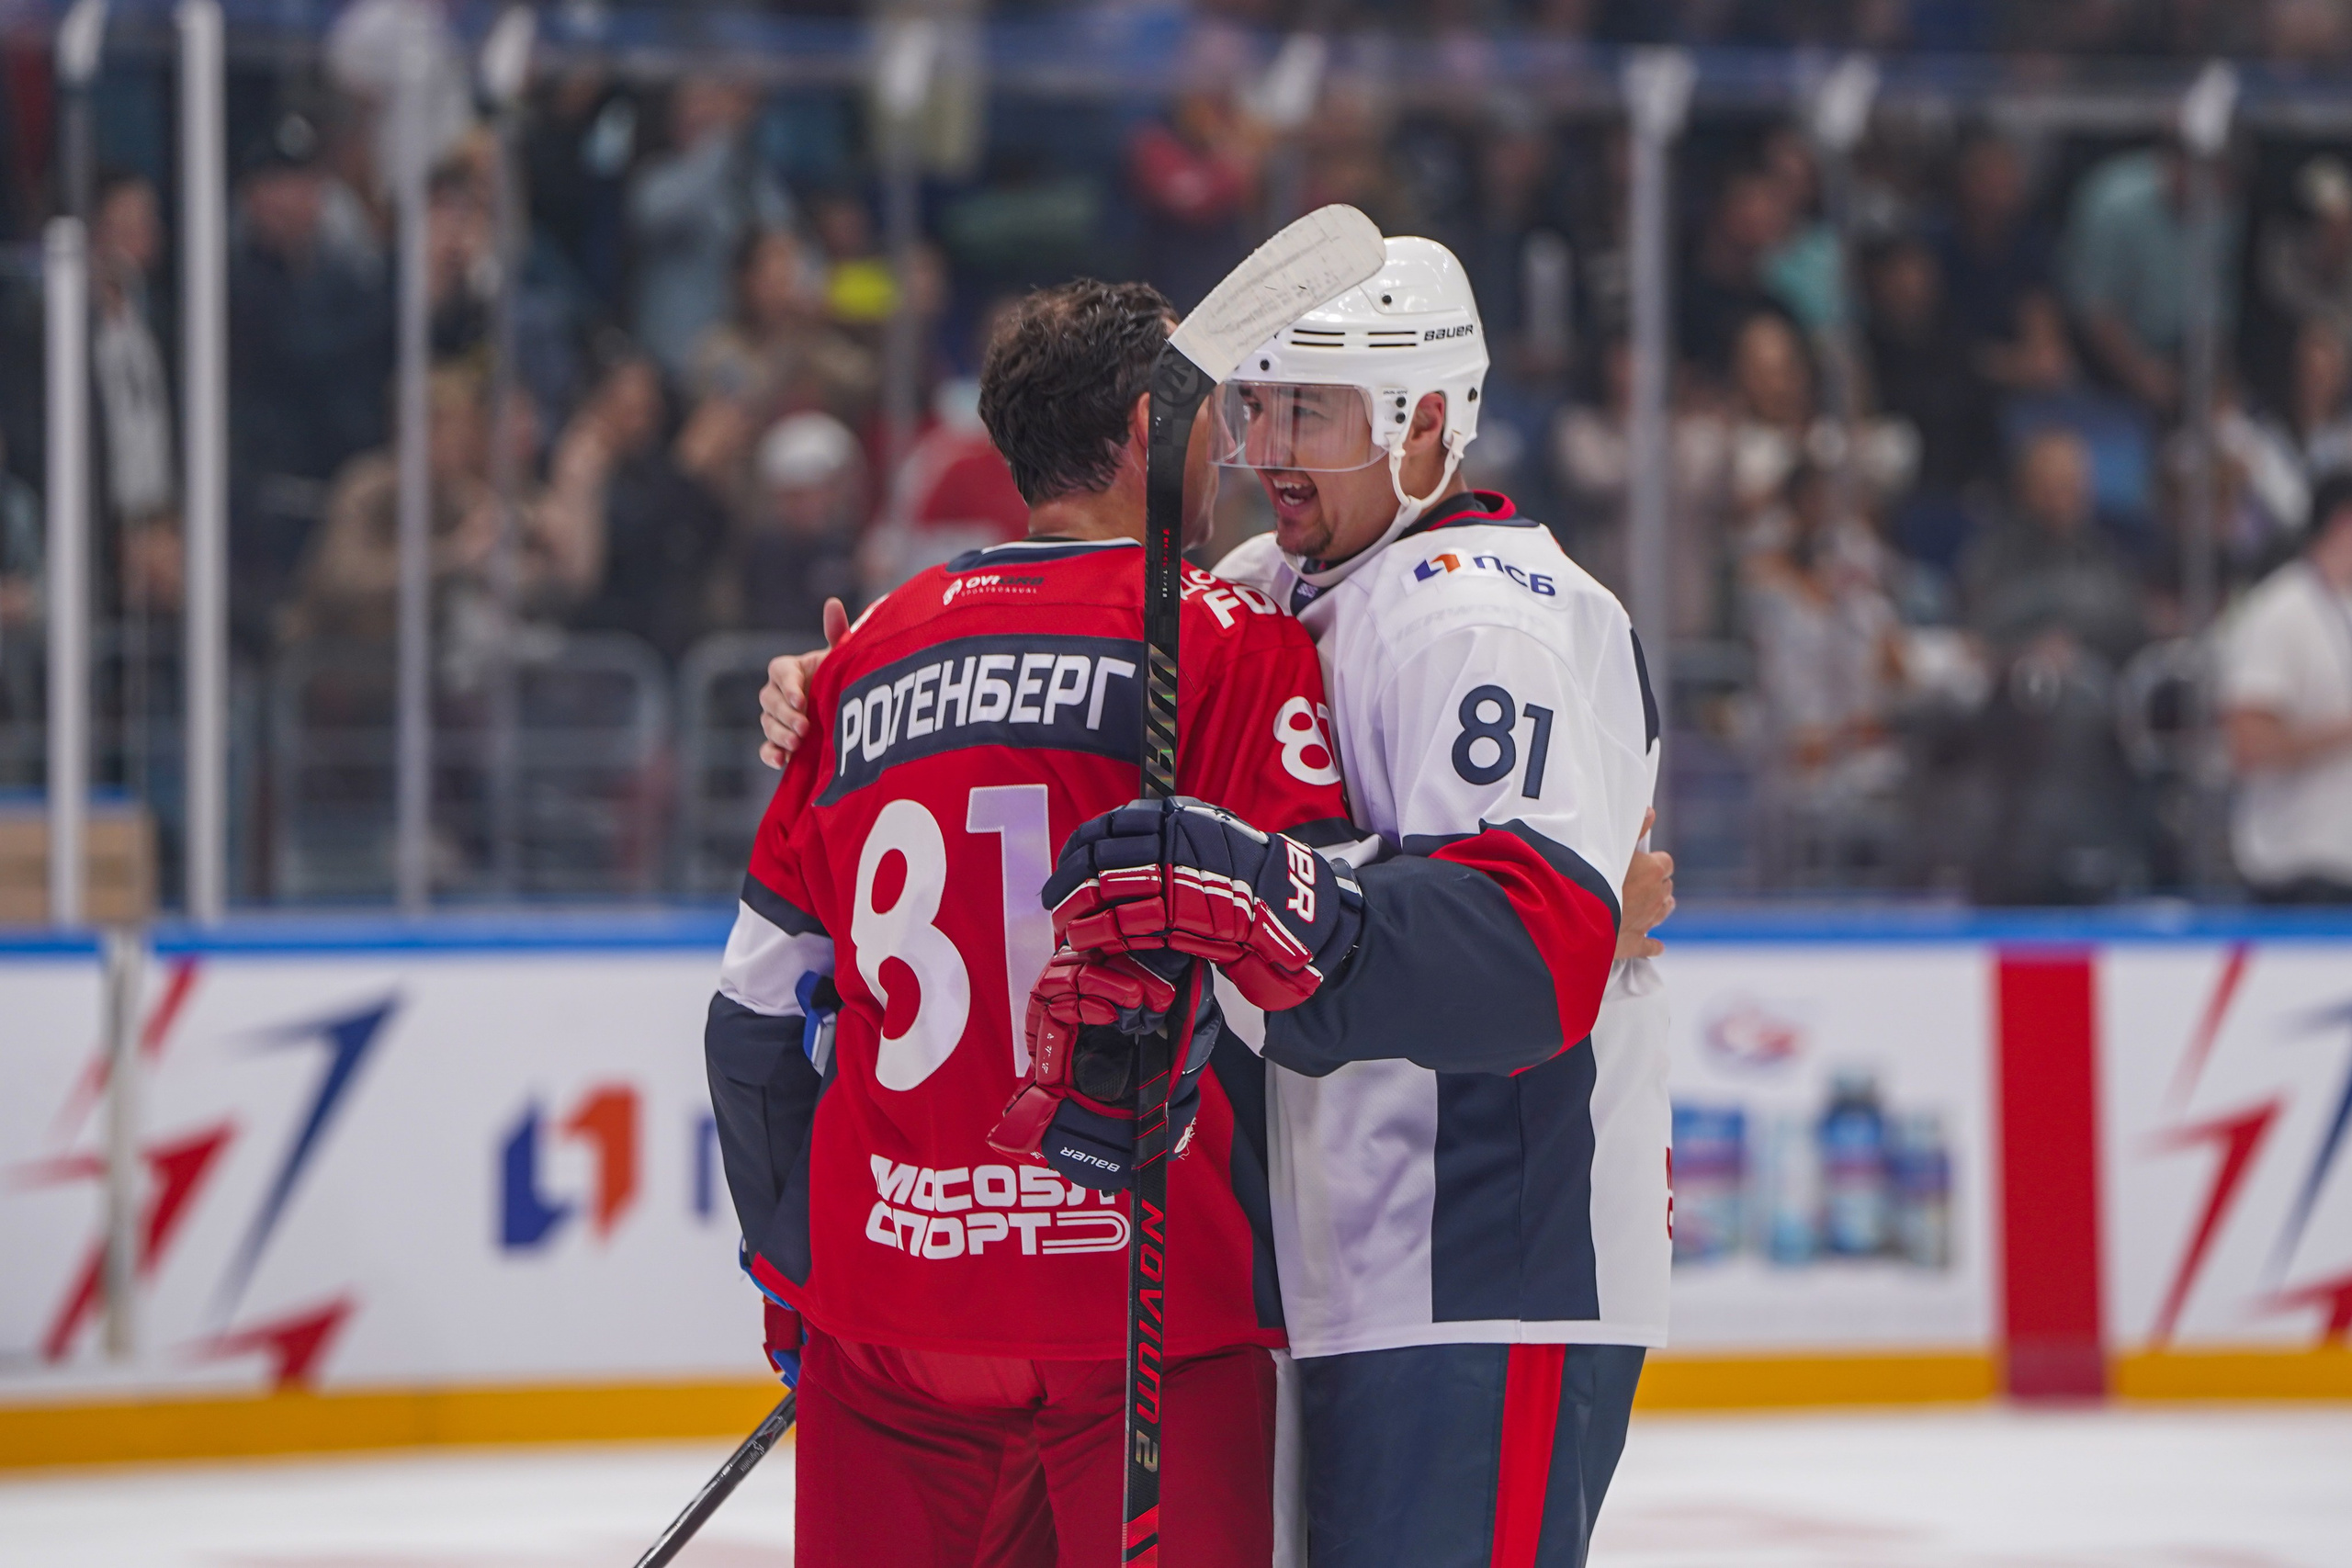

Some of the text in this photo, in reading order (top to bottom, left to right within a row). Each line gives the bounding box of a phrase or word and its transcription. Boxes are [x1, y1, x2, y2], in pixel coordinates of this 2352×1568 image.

[1424, 323, 1473, 341] BAUER
[1472, 555, 1556, 597] ПСБ
[840, 652, 1136, 777] РОТЕНБЕРГ
[1452, 684, 1554, 800] 81
[851, 783, 1056, 1091] 81
[1059, 1146, 1121, 1173] BAUER
[865, 1200, 1052, 1260] СПОРТ
[1136, 1199, 1165, 1473] NOVIUM 2
